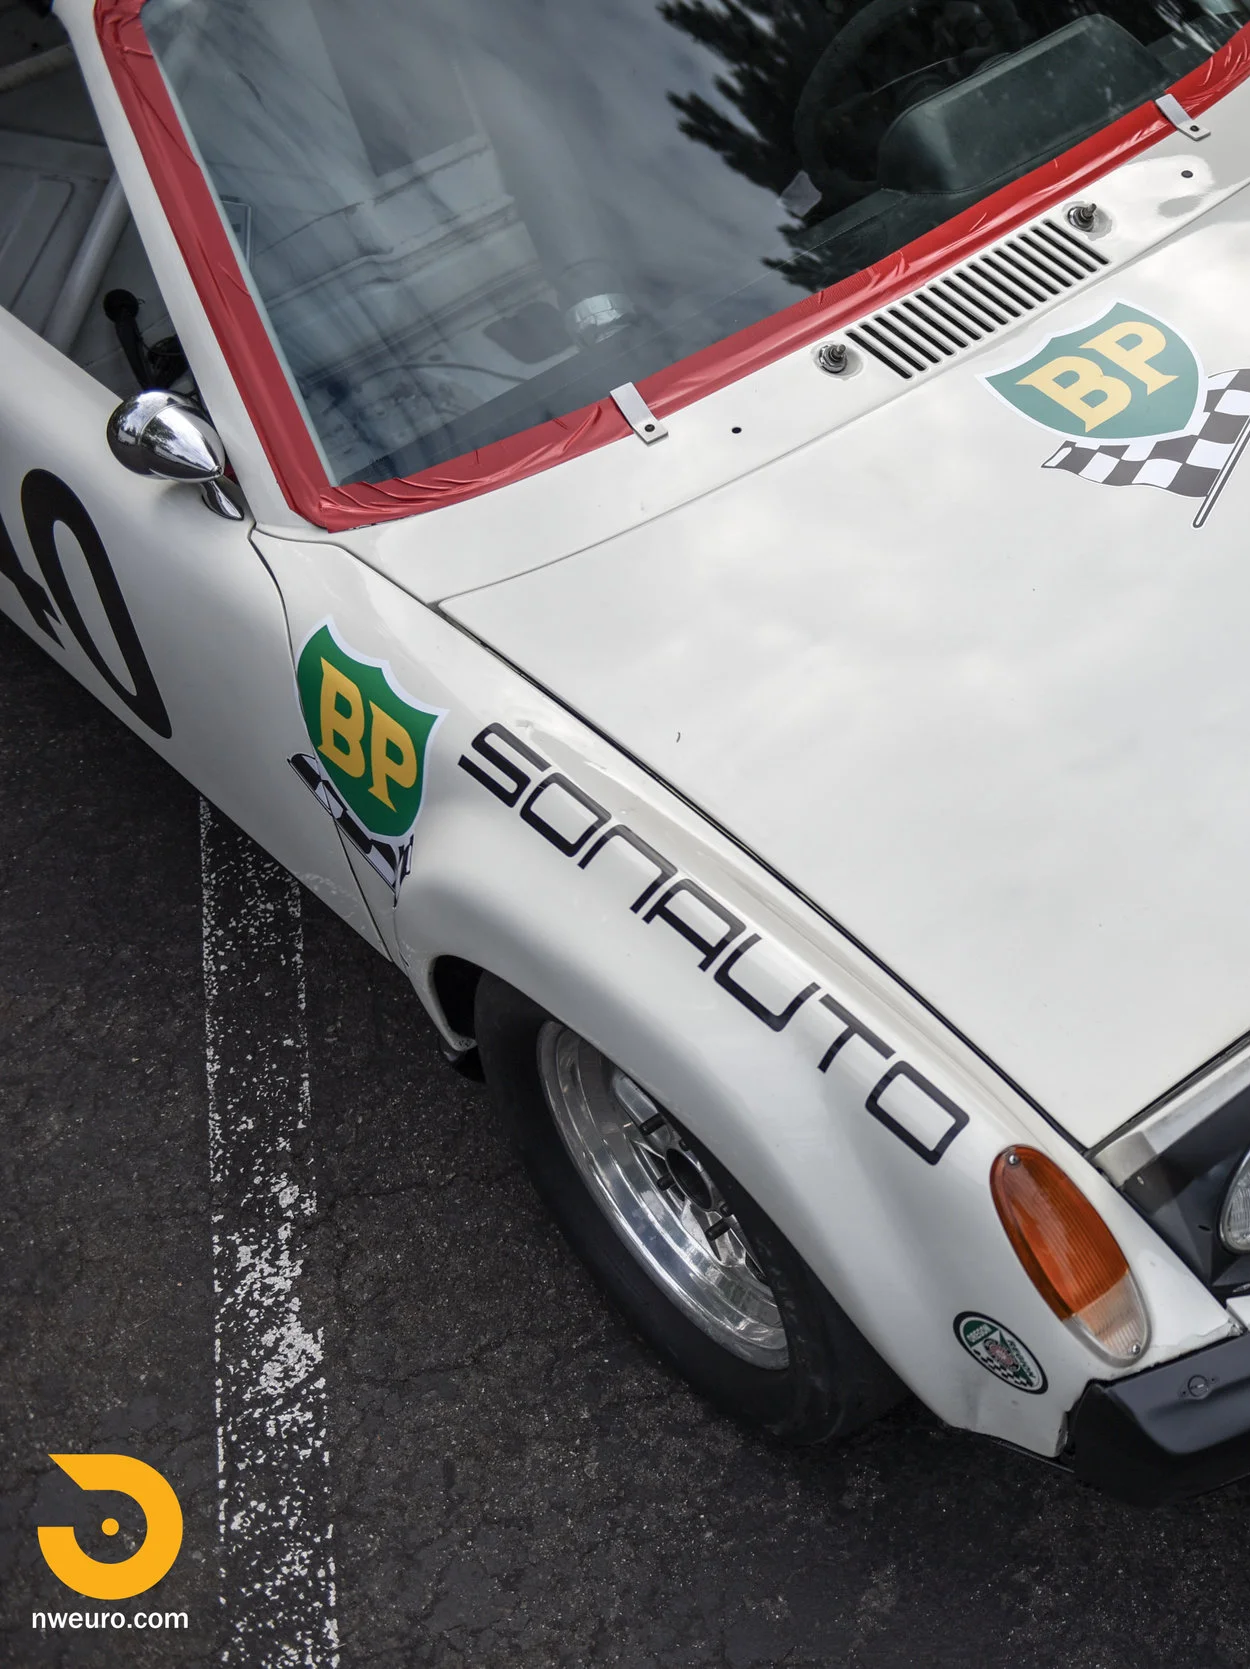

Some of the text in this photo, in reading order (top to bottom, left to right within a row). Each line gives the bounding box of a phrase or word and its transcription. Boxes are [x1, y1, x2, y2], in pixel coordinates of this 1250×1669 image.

[1015, 321, 1180, 433] BP
[317, 656, 418, 812] BP
[457, 722, 970, 1165] SONAUTO
